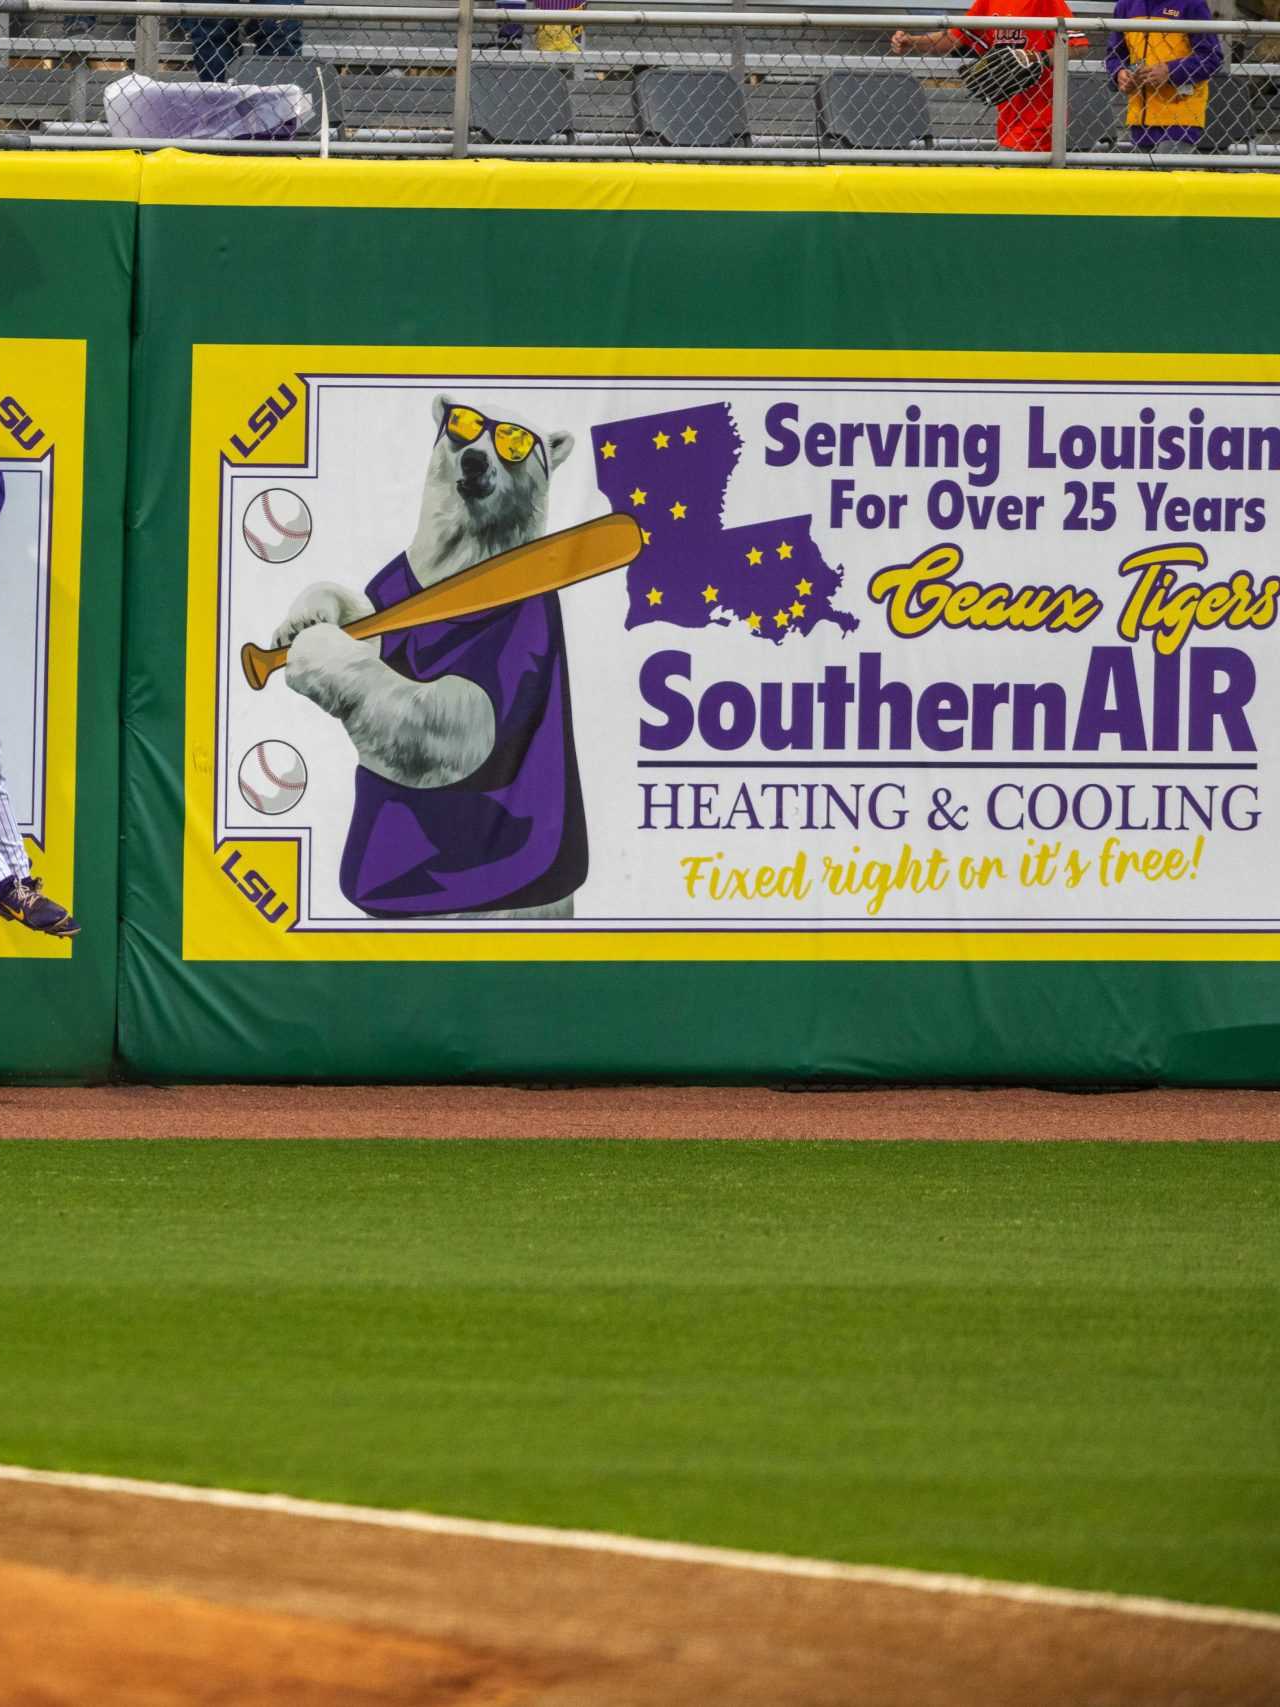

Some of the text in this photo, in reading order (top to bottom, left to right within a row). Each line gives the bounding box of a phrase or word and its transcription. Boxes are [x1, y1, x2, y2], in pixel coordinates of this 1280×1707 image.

[229, 383, 298, 458] LSU
[764, 402, 1001, 488] Serving
[830, 479, 1266, 533] For Over 25 Years
[867, 541, 1280, 655] Geaux Tigers
[638, 645, 1258, 753] SouthernAIR
[637, 781, 1263, 833] HEATING & COOLING
[221, 850, 289, 923] LSU
[679, 834, 1206, 916] Fixed right or it's free!
